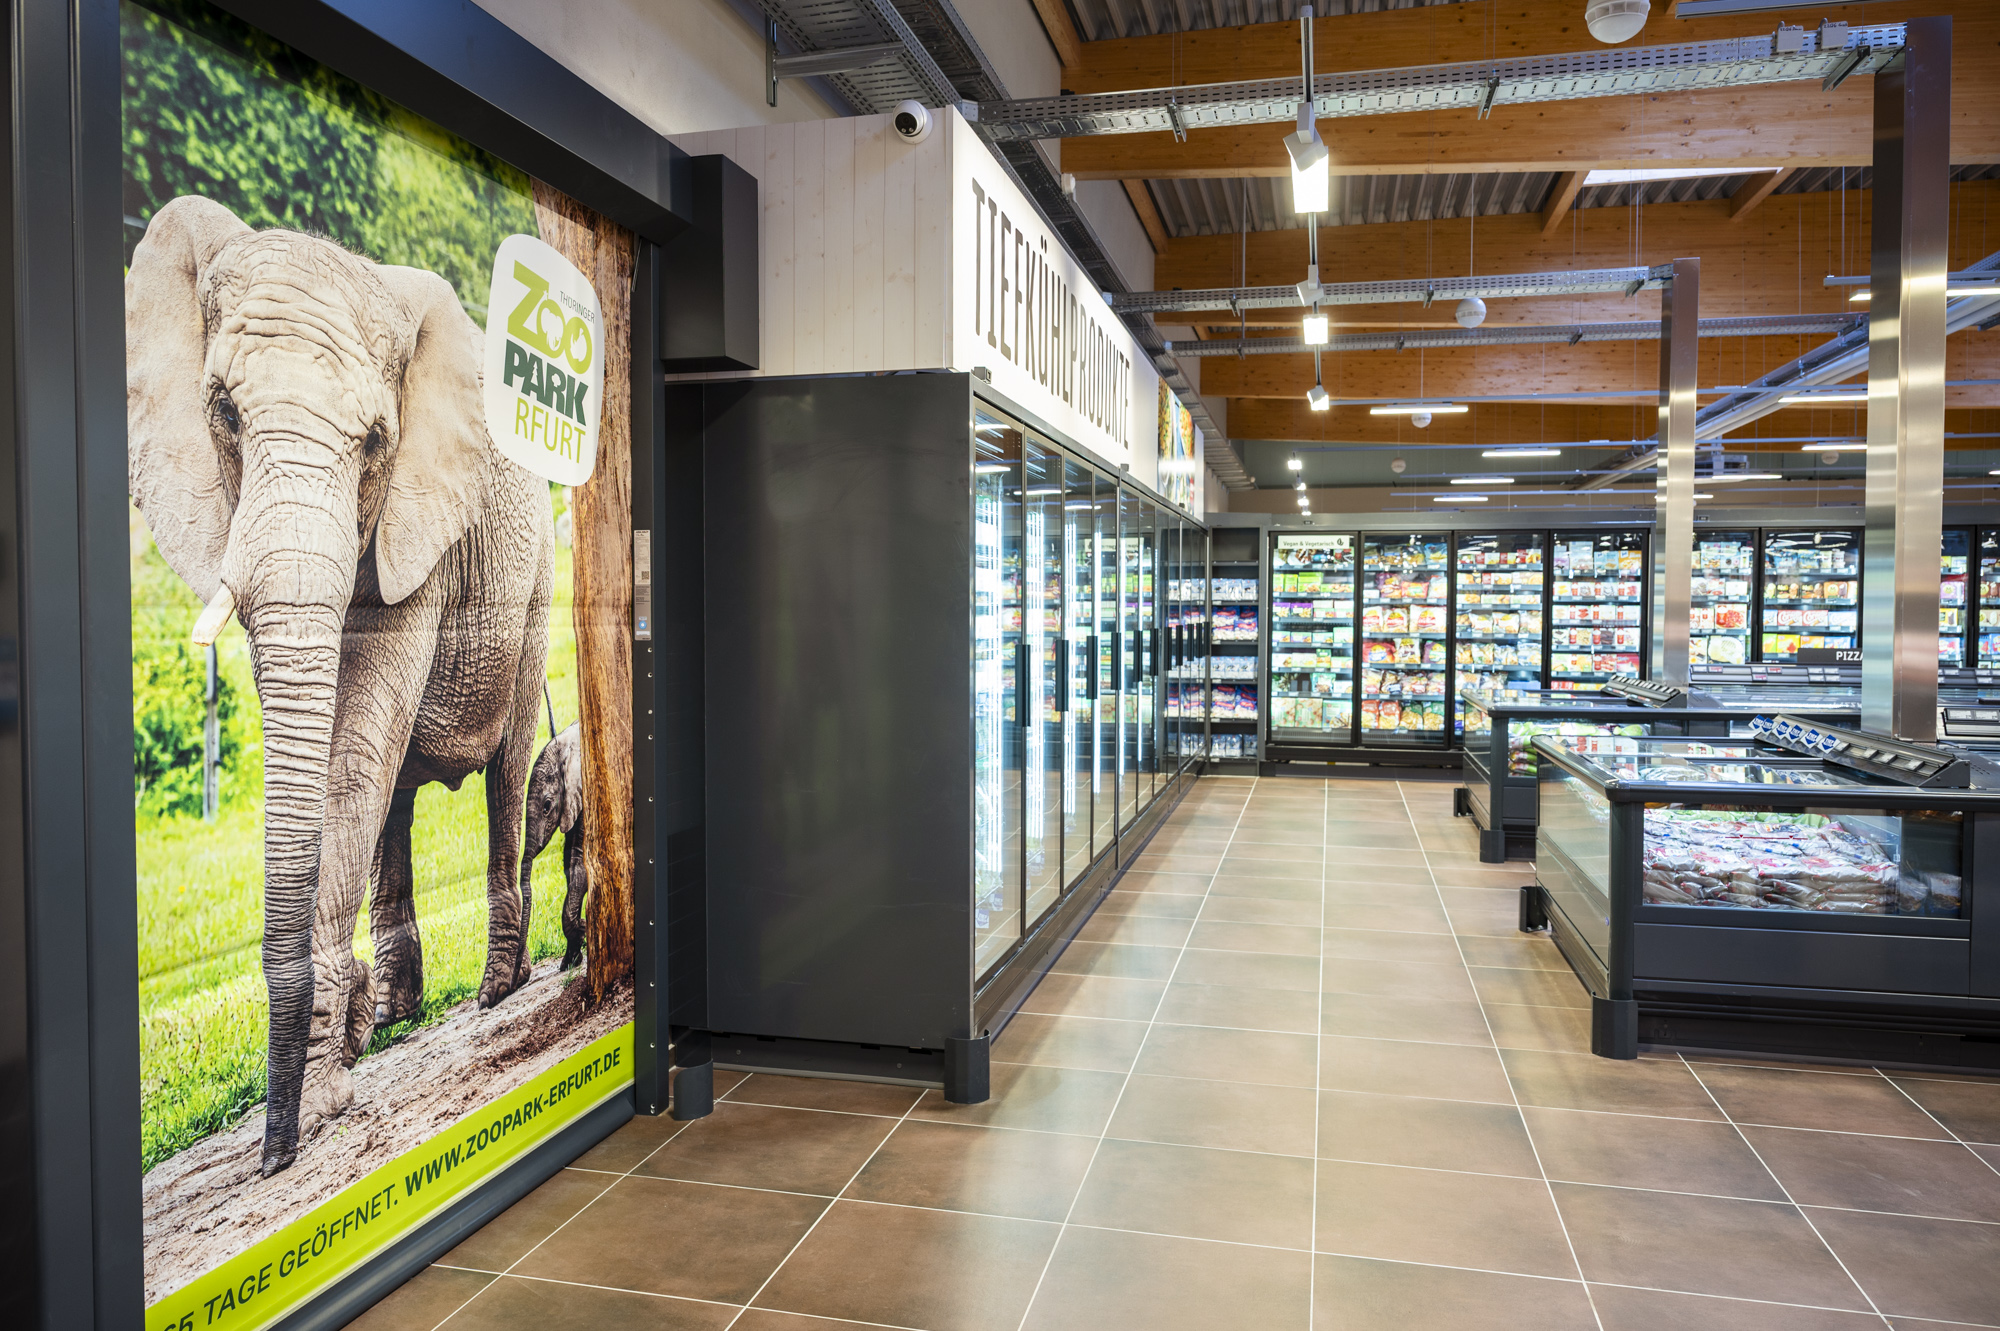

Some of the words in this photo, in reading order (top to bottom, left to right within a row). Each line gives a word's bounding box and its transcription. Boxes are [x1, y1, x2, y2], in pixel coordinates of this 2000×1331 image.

[507, 260, 593, 375] ZOO
[971, 177, 1131, 451] TIEFKÜHLPRODUKTE
[503, 338, 589, 427] PARK
[514, 396, 586, 464] RFURT
[203, 1261, 273, 1326] TAGE
[279, 1182, 399, 1278] GEÖFFNET.
[404, 1046, 621, 1197] WWW.ZOOPARK-ERFURT.DE
